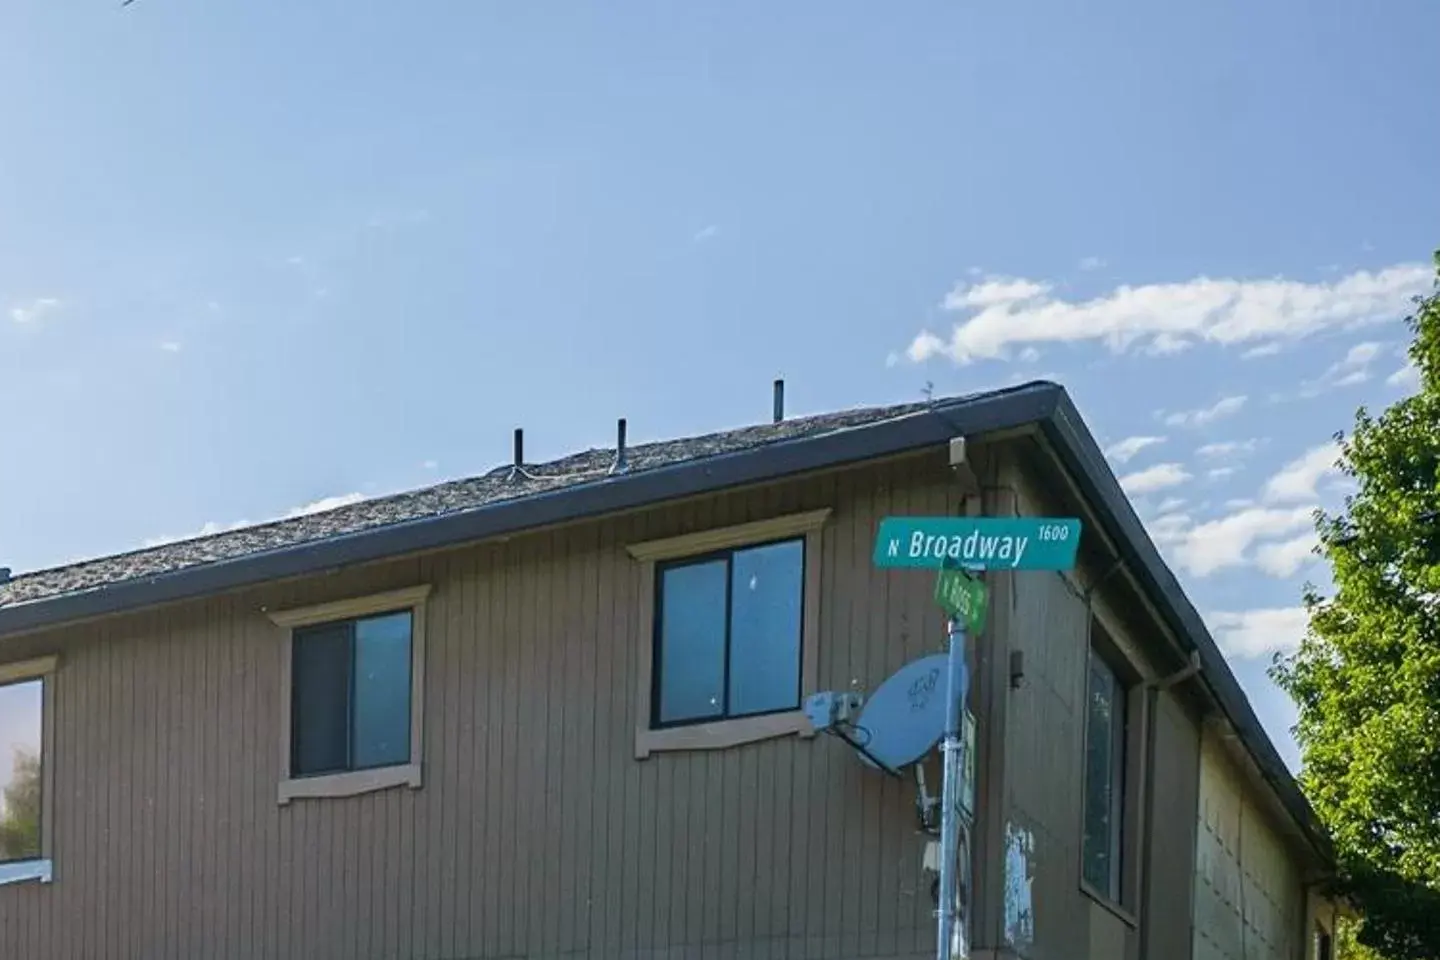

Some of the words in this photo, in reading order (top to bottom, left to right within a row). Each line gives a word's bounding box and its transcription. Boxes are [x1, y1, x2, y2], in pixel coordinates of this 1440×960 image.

[888, 538, 900, 557] N
[908, 529, 1027, 567] Broadway
[1038, 524, 1069, 541] 1600
